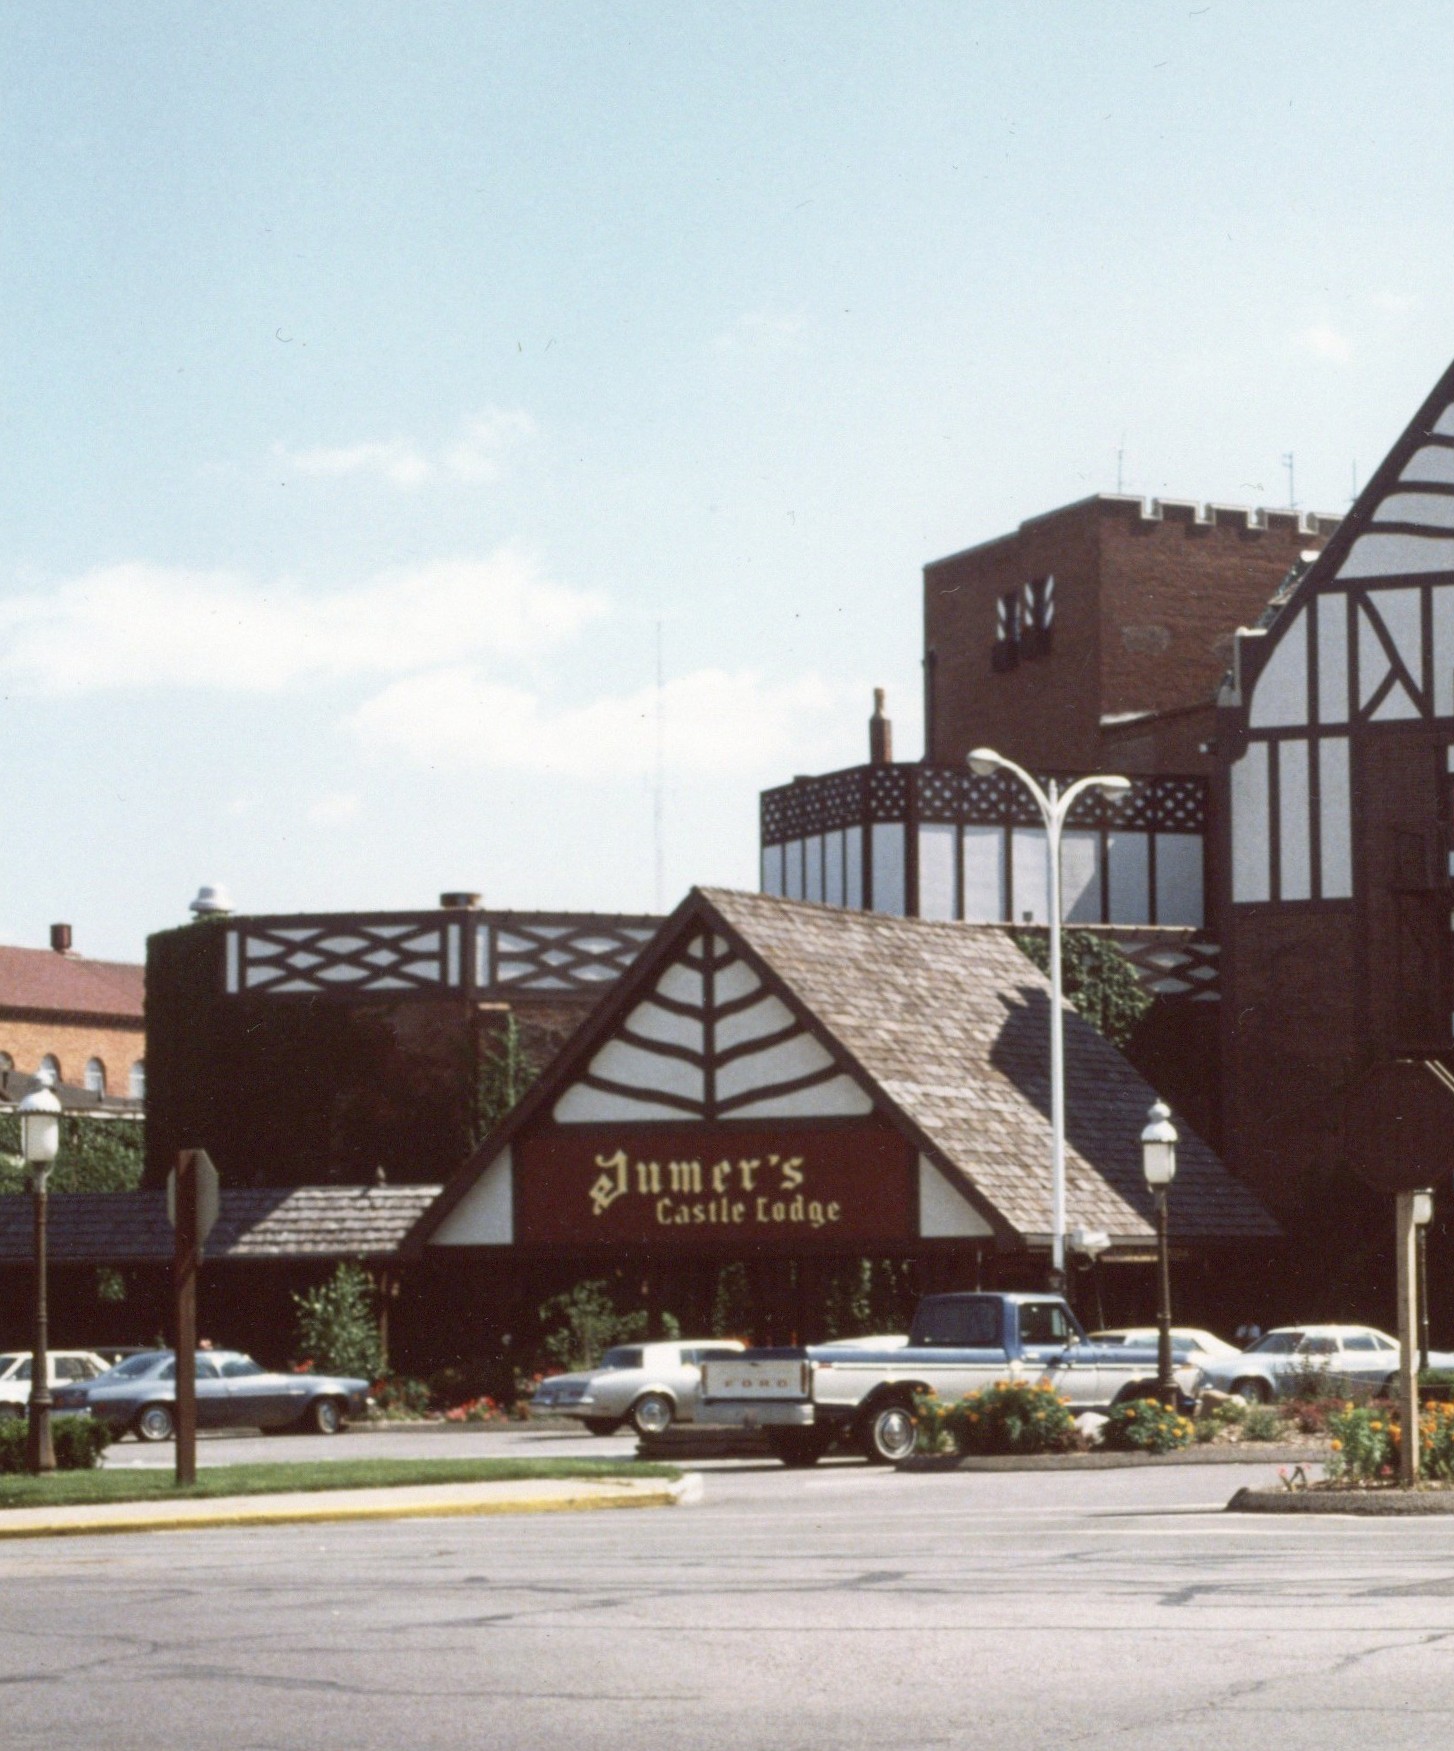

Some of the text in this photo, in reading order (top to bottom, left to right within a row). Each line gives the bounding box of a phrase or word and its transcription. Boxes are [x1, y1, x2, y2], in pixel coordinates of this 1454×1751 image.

[589, 1149, 804, 1215] Jumer's
[656, 1195, 841, 1227] Castle Lodge
[724, 1378, 788, 1388] FORD
